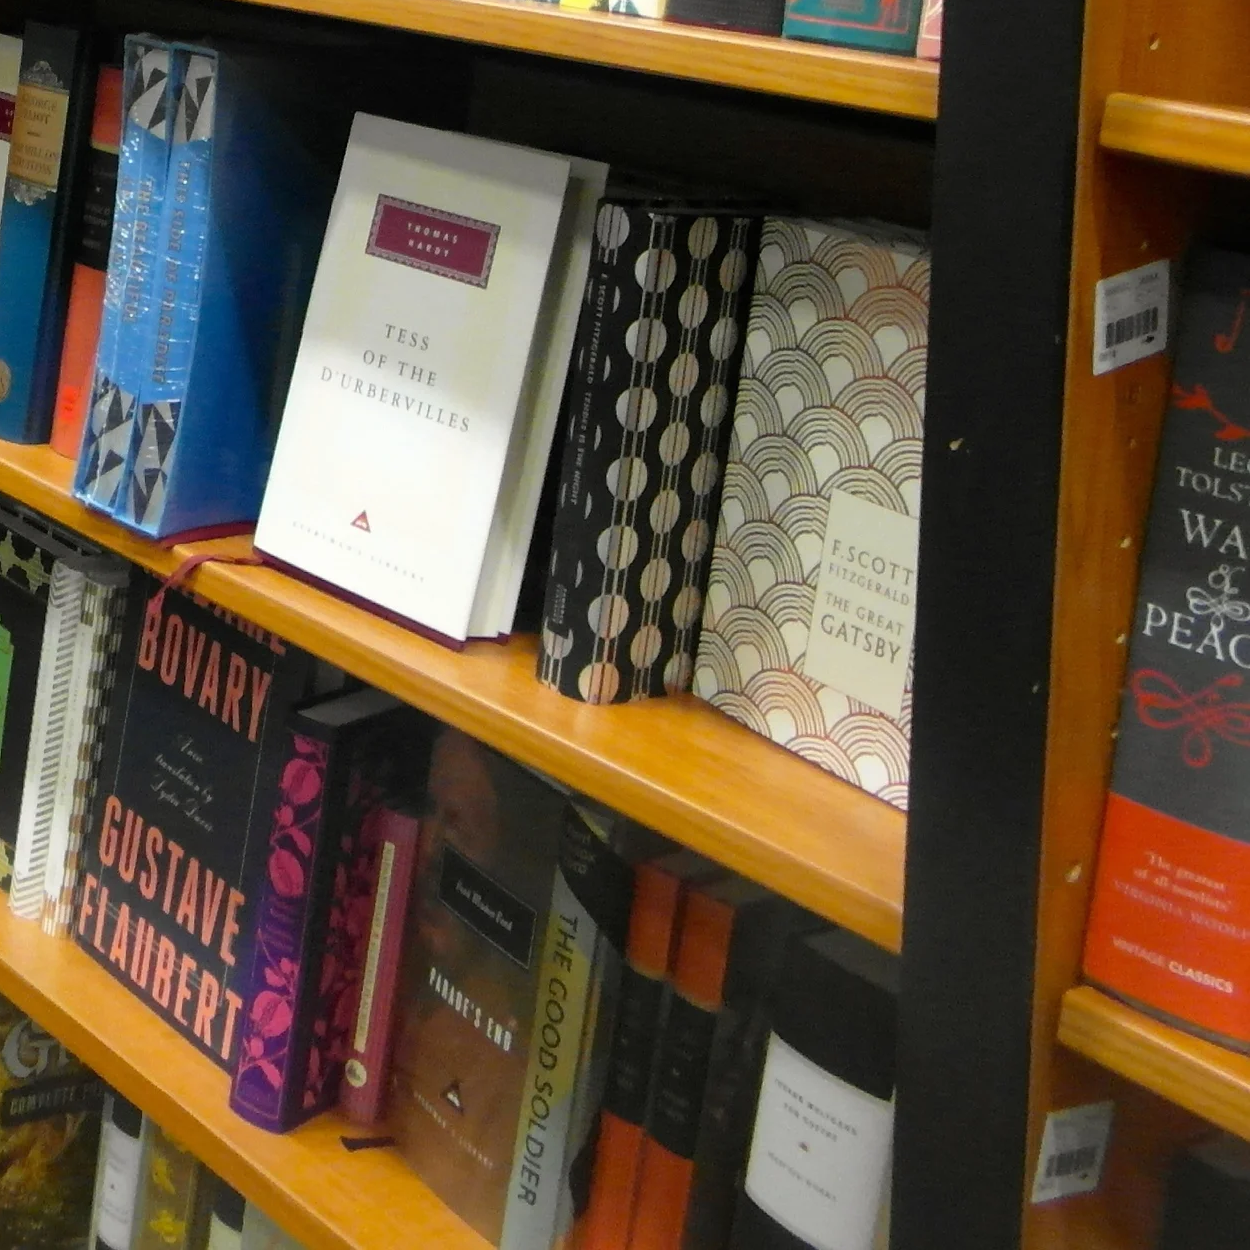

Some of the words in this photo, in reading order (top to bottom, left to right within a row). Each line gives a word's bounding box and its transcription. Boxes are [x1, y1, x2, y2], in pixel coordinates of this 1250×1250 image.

[406, 222, 459, 245] THOMAS
[408, 239, 450, 258] HARDY
[384, 322, 430, 352] TESS
[363, 348, 388, 369] OF
[398, 360, 438, 387] THE
[320, 365, 471, 433] D'URBERVILLES
[828, 562, 910, 606] FITZGERALD
[820, 613, 902, 664] GATSBY
[825, 591, 851, 613] THE
[856, 606, 905, 637] GREAT
[137, 608, 272, 743] BOVARY
[98, 794, 246, 967] GUSTAVE
[77, 873, 244, 1062] FLAUBERT
[558, 915, 579, 984] THE
[1168, 959, 1235, 995] CLASSICS
[429, 966, 482, 1029] PARADE'S
[486, 1016, 513, 1051] END
[536, 981, 571, 1074] GOOD
[516, 1076, 555, 1208] SOLDIER
